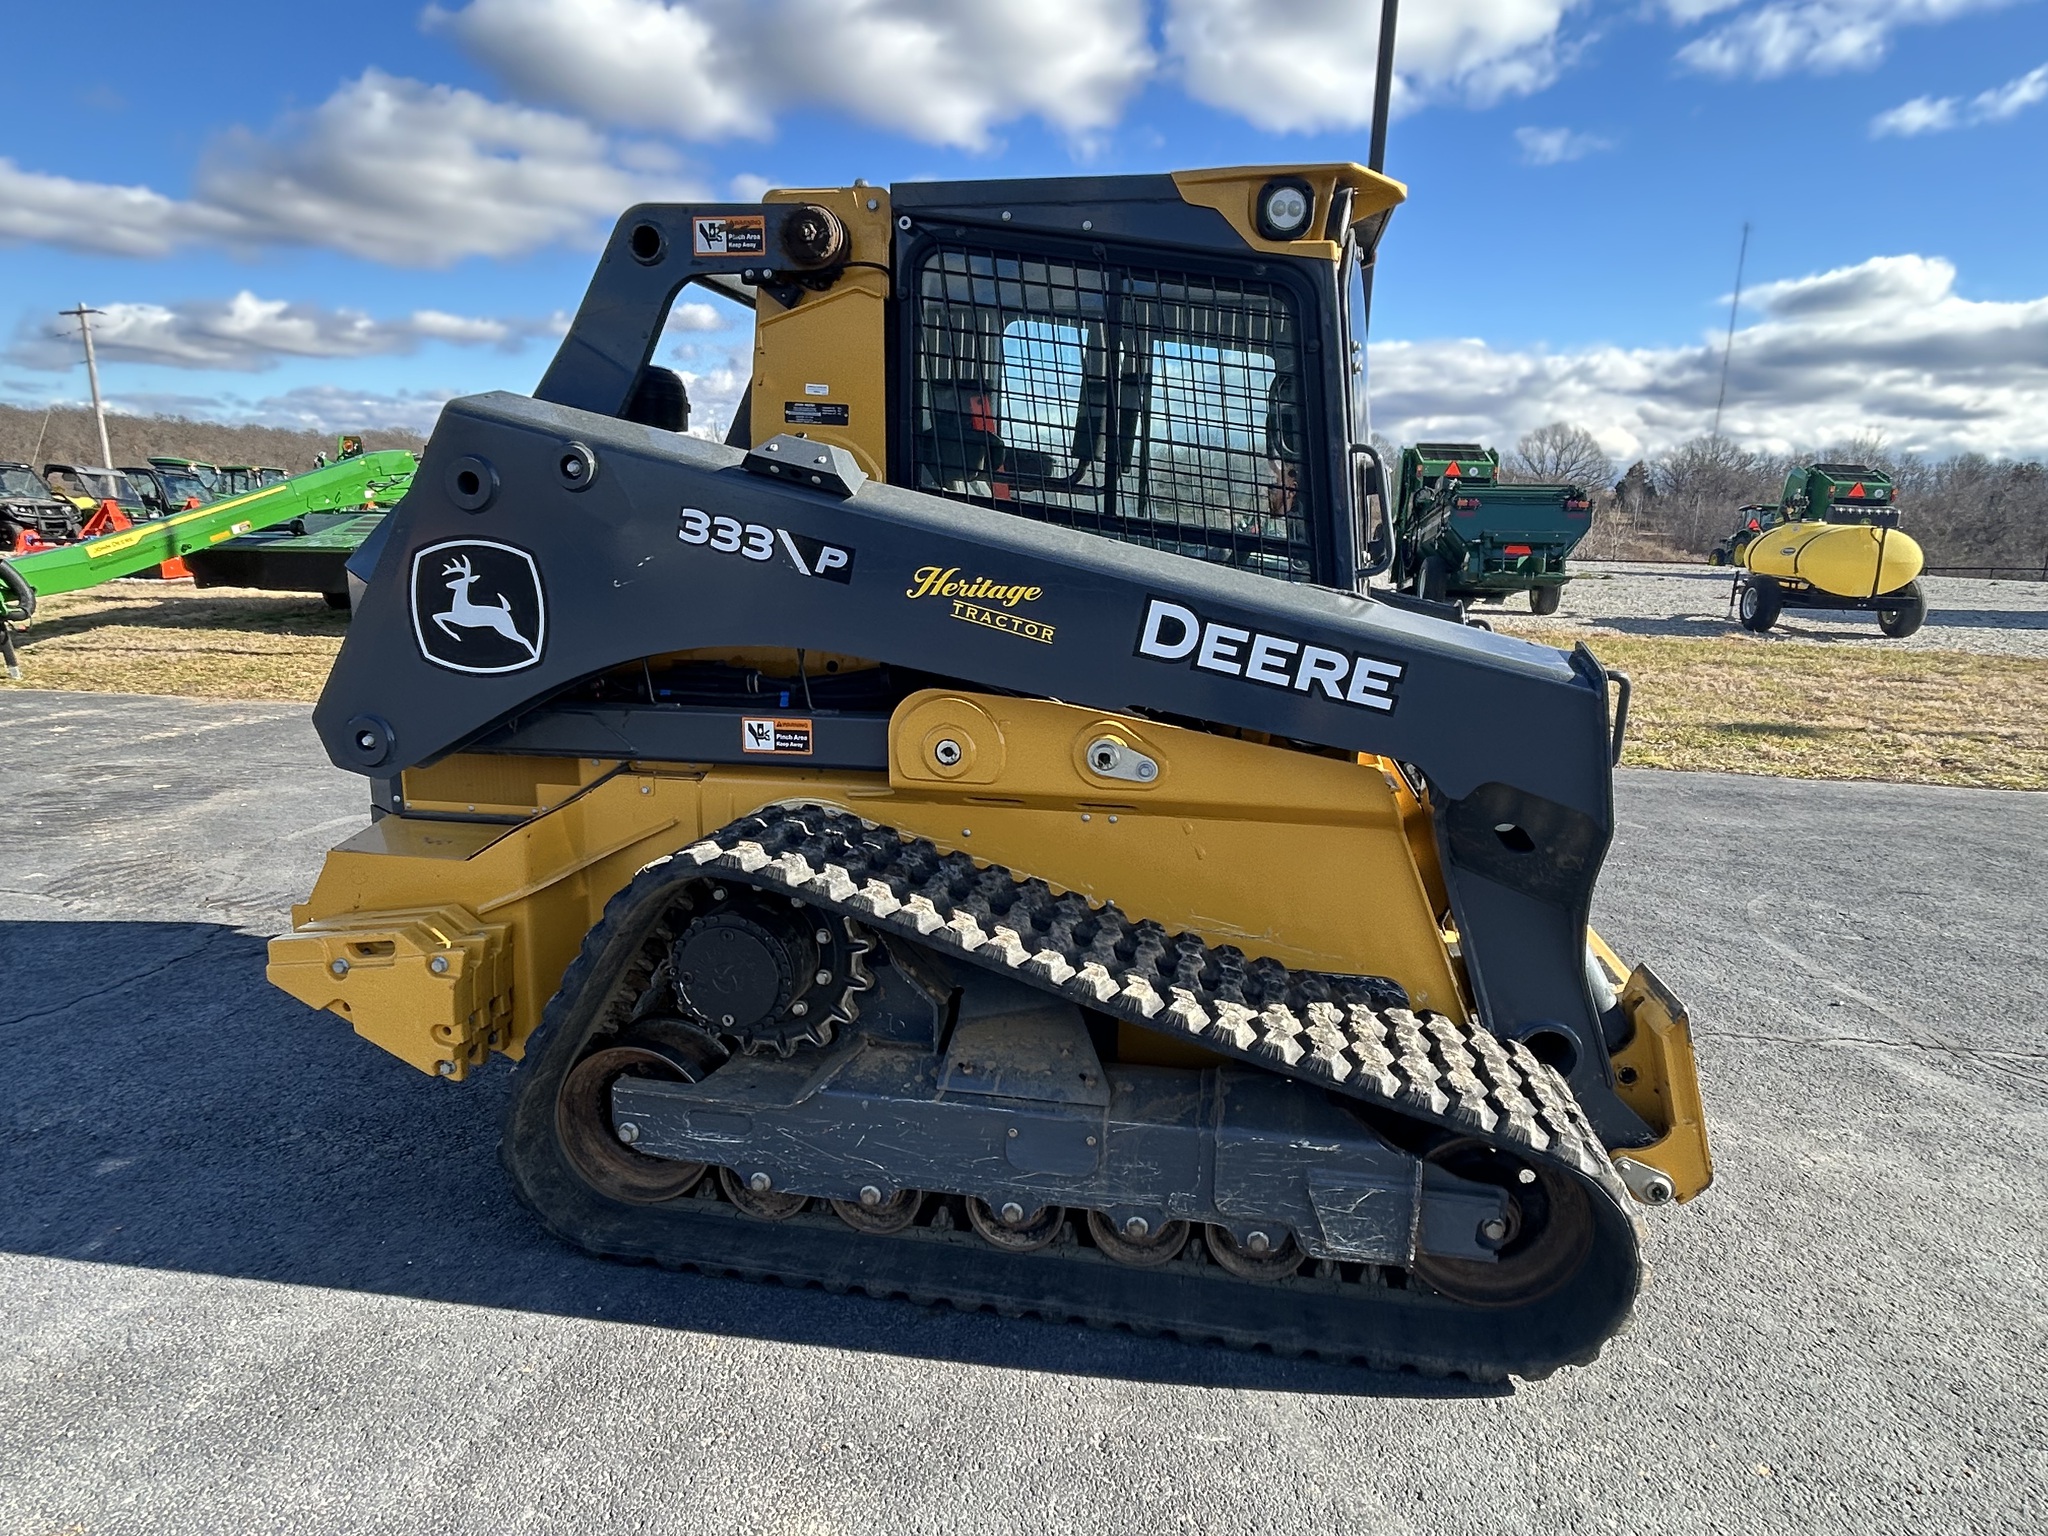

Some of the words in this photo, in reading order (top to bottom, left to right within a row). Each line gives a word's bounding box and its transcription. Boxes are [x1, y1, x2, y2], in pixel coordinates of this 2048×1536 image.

[678, 508, 775, 561] 333
[906, 566, 1044, 607] Heritage
[952, 602, 1055, 641] TRACTOR
[1139, 599, 1402, 710] DEERE
